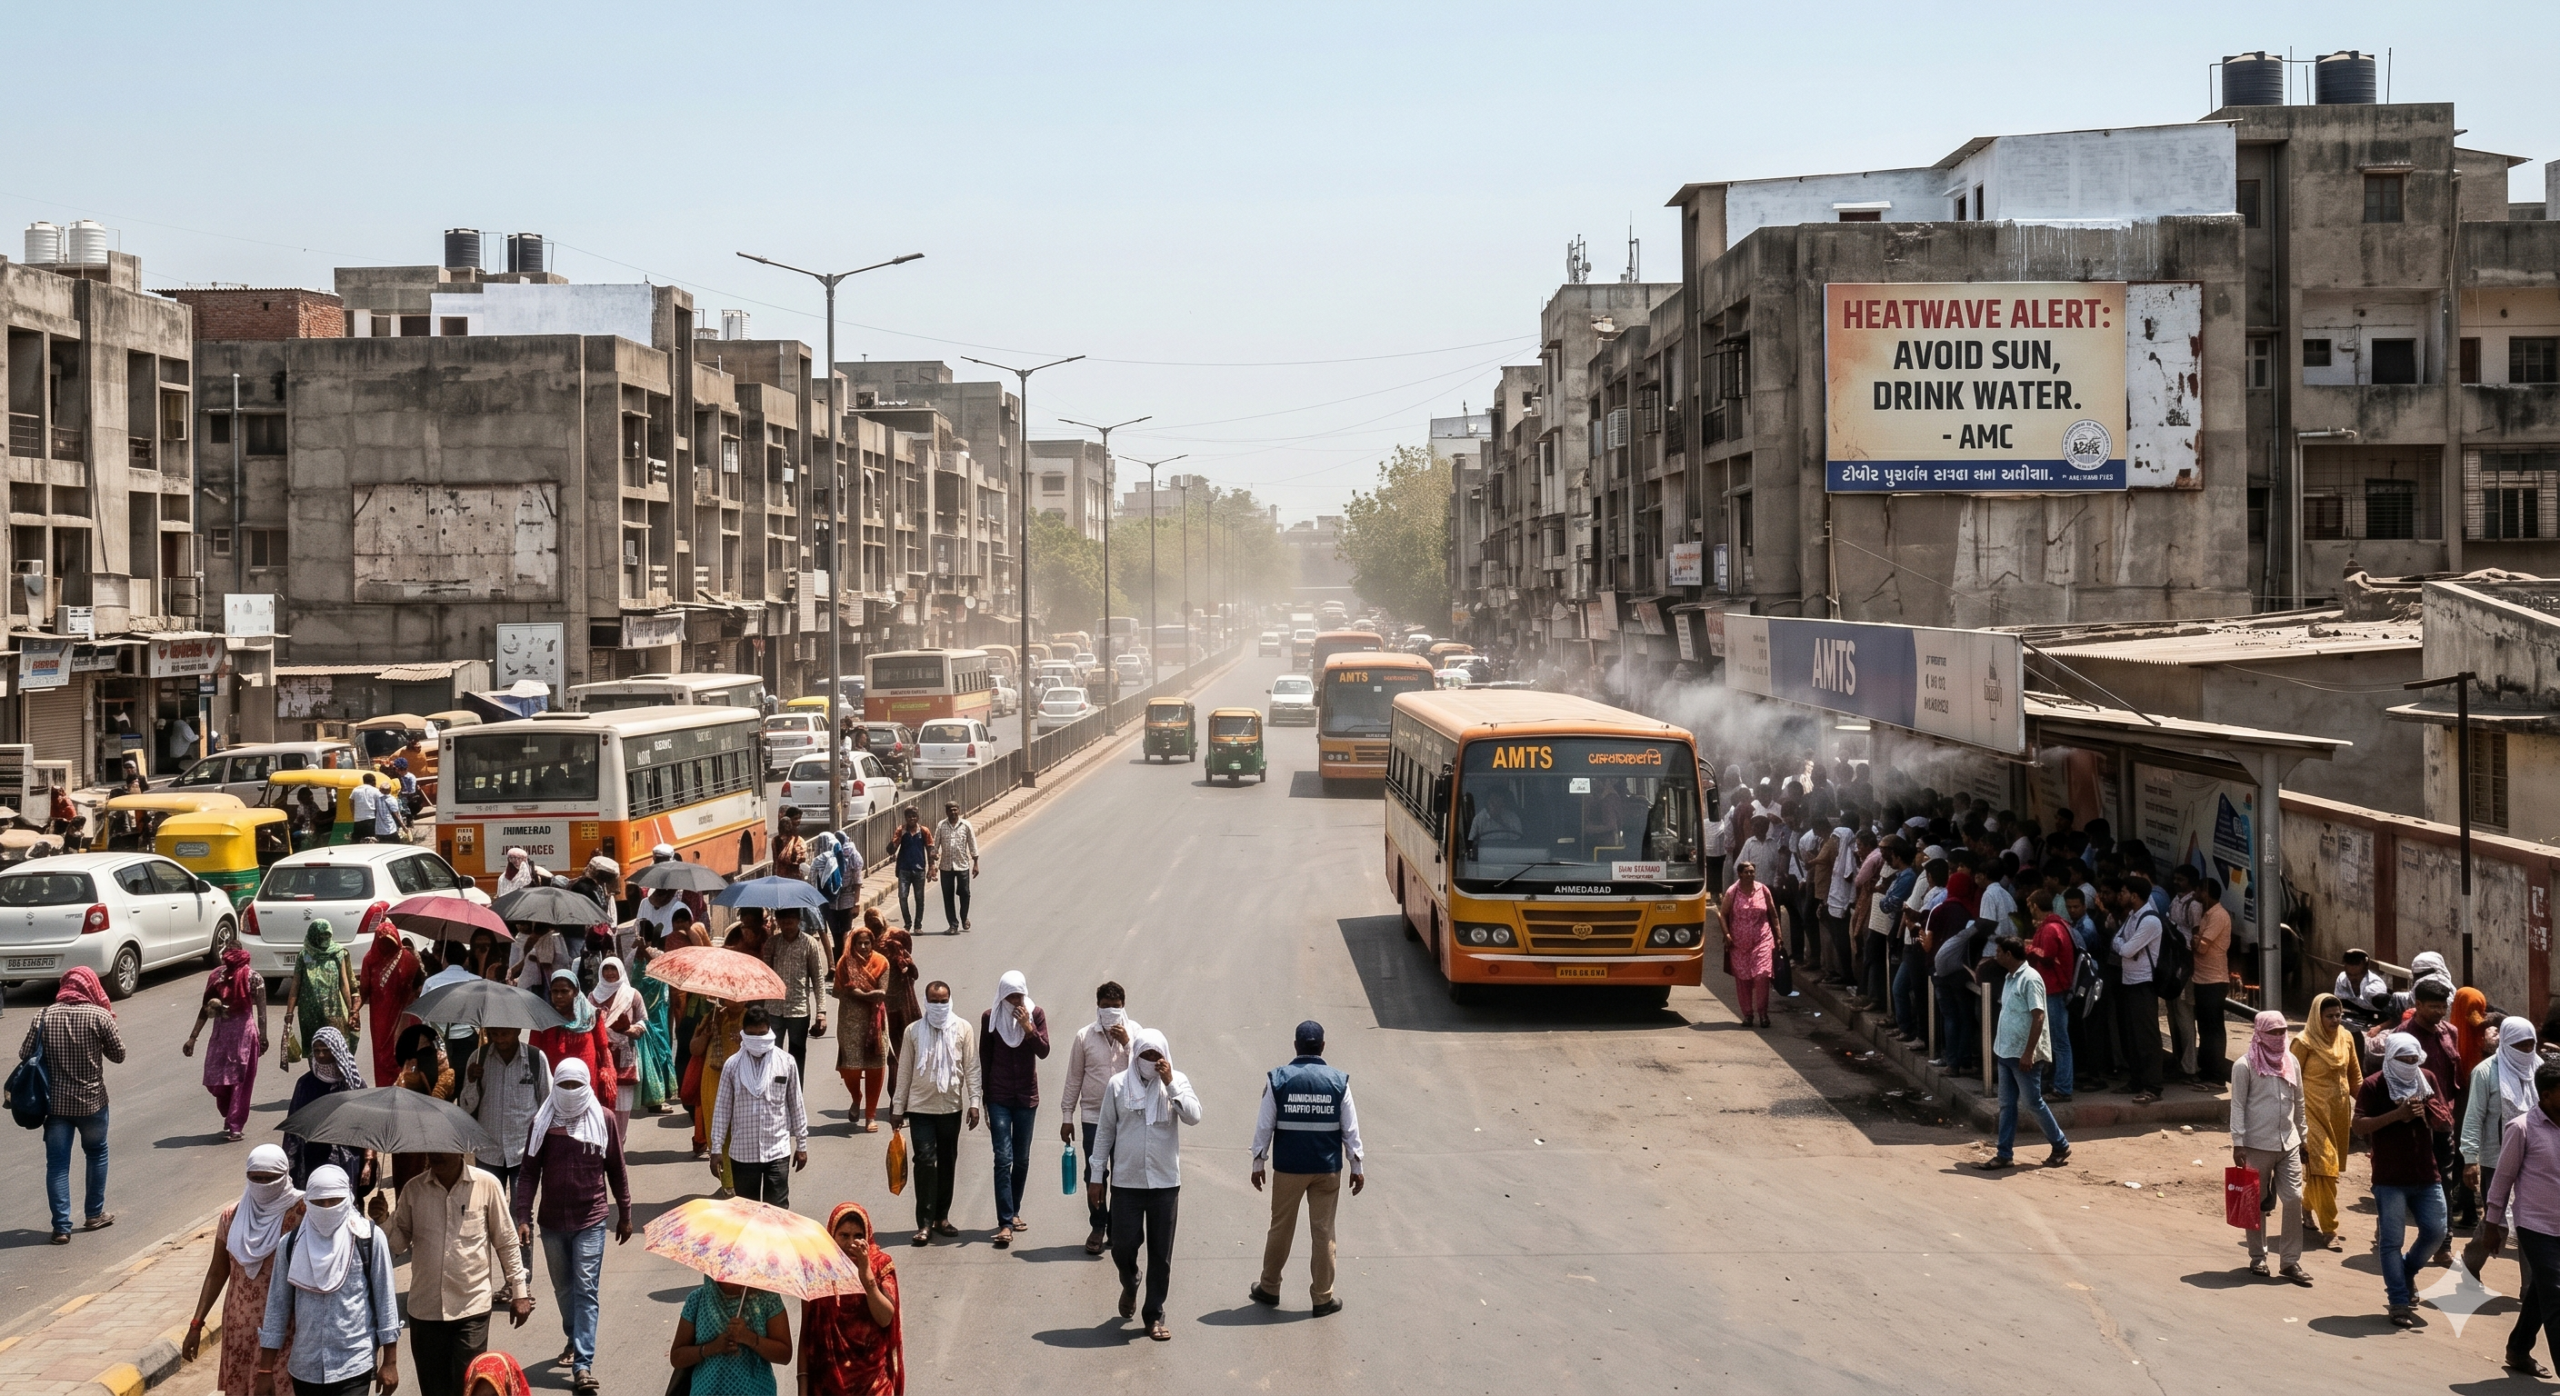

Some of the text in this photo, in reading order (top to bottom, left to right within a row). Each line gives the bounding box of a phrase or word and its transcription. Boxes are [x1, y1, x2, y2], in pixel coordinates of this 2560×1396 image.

[1843, 299, 2111, 329] HEATWAVE ALERT:
[1893, 339, 2061, 375] AVOID SUN,
[1873, 380, 2082, 411] DRINK WATER.
[1958, 423, 2013, 450] AMC
[1339, 671, 1369, 683] AMTS
[1812, 637, 1857, 696] AMTS
[1492, 745, 1553, 769] AMTS
[1554, 885, 1612, 894] AHMEDABAD
